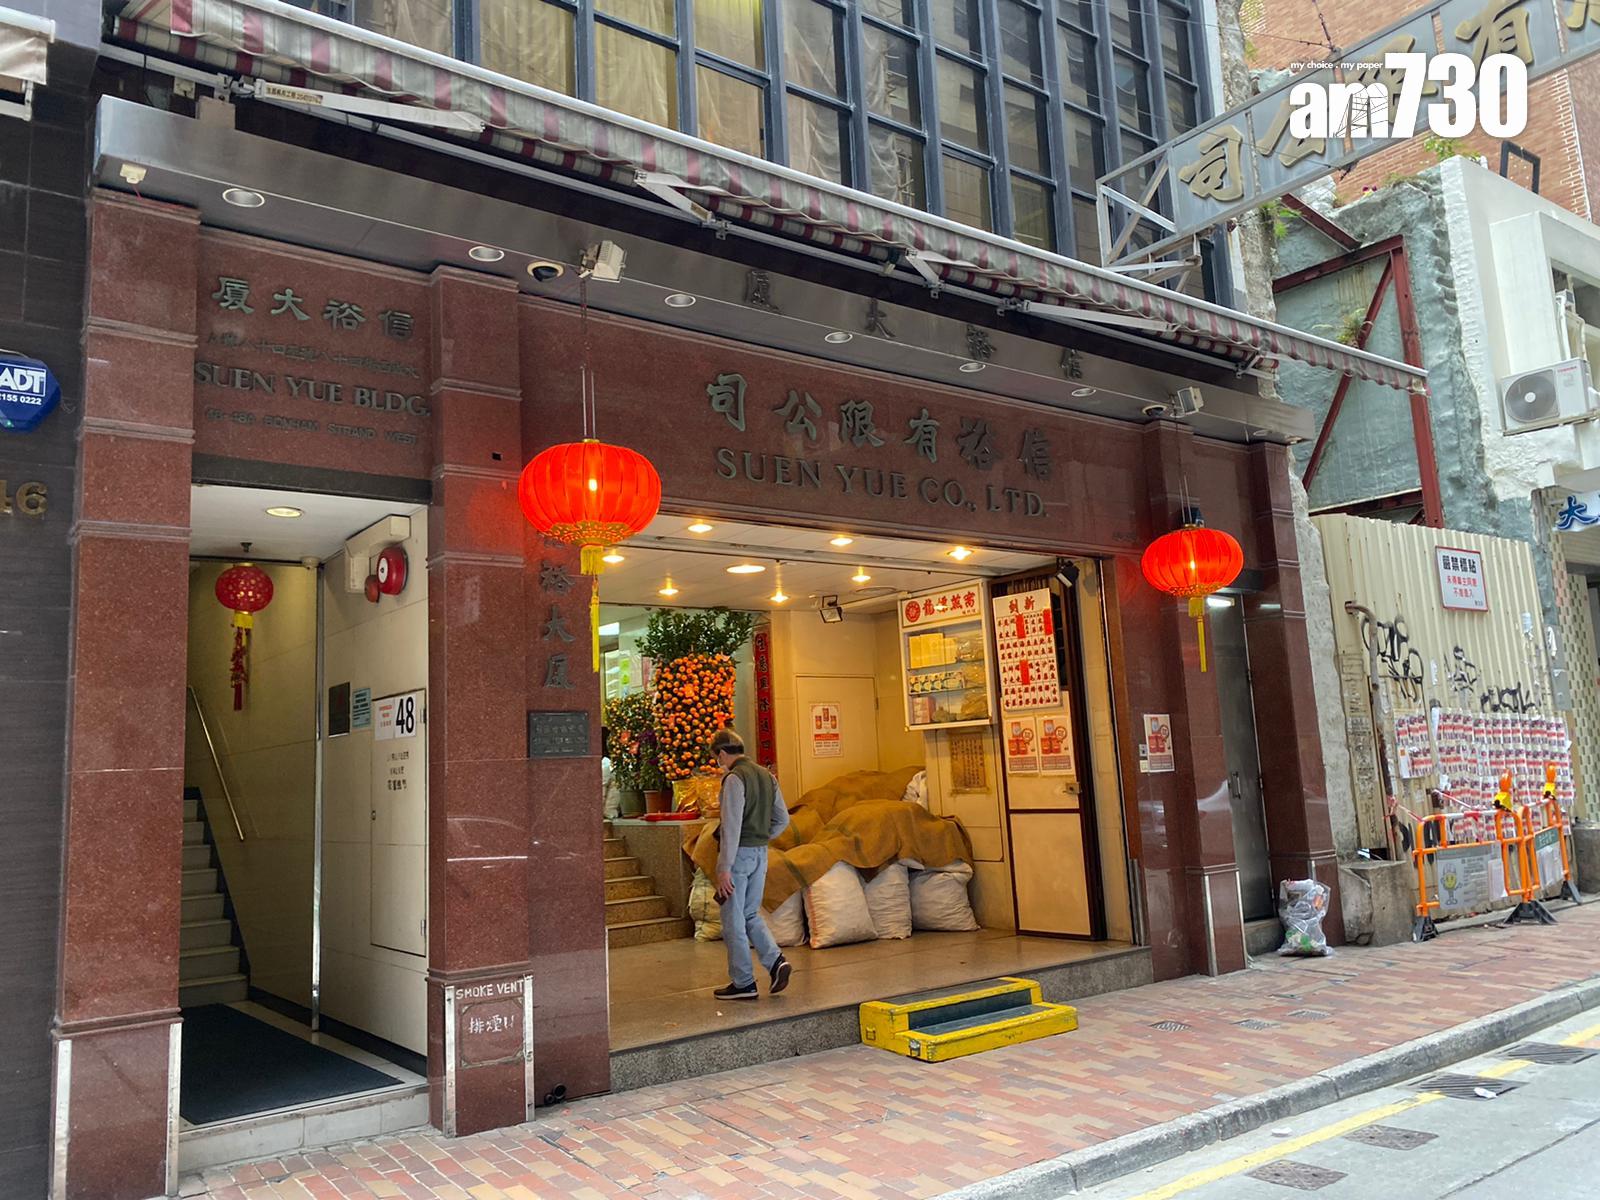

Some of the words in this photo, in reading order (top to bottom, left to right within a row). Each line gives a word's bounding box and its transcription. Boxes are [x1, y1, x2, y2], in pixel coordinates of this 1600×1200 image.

[0, 366, 46, 395] ADT
[194, 361, 277, 396] SUEN
[285, 375, 344, 405] YUE
[354, 385, 431, 418] BLDG.
[20, 394, 42, 406] 0222
[328, 423, 377, 440] STRAND
[384, 430, 418, 446] WEST
[715, 447, 823, 489] SUEN
[835, 463, 909, 500] YUE
[396, 696, 415, 734] 48
[456, 983, 494, 1000] SMOKE
[497, 979, 524, 994] VENT
